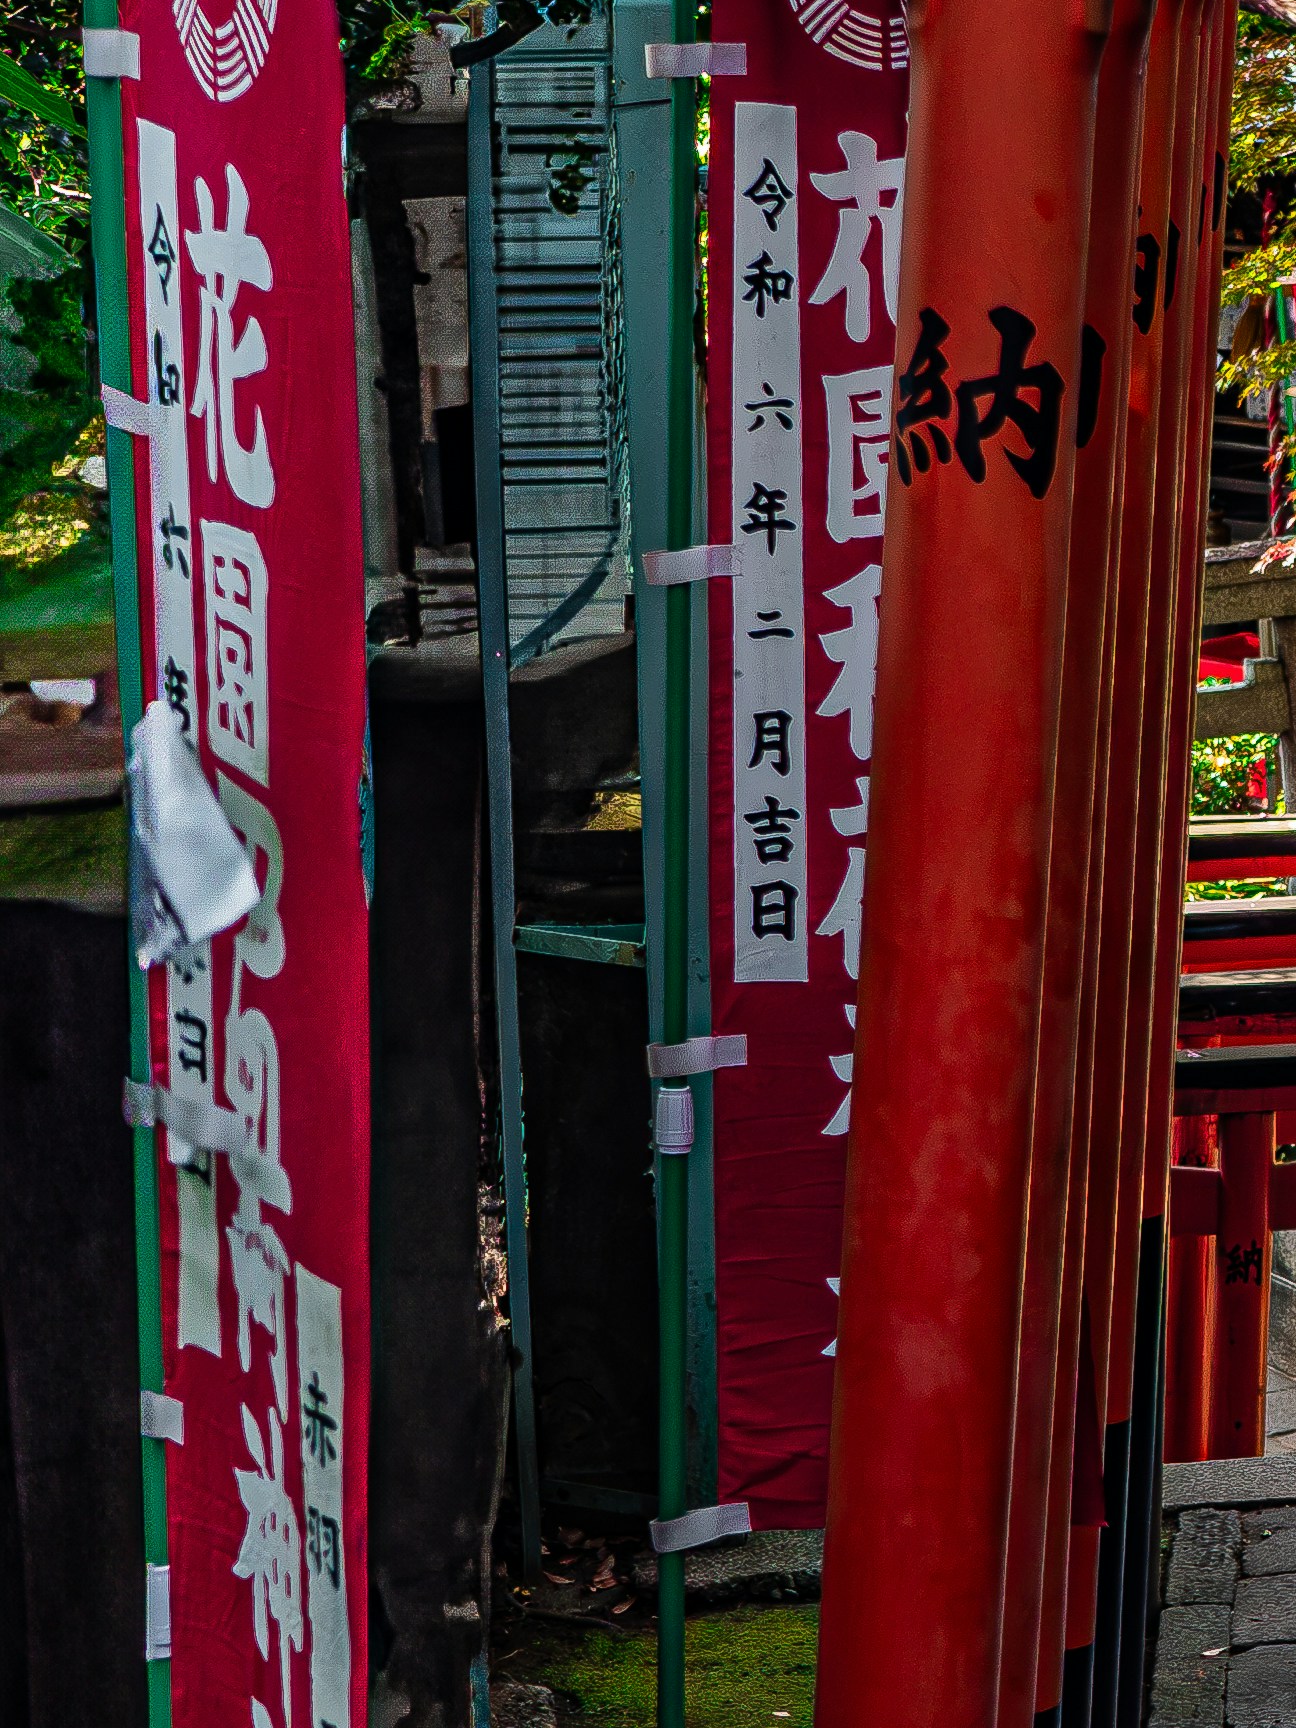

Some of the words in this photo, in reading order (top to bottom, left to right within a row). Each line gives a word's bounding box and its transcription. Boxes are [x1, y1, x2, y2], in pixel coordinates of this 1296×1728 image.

[740, 157, 801, 941] 令和六年二月吉日
[896, 306, 1066, 500] 納
